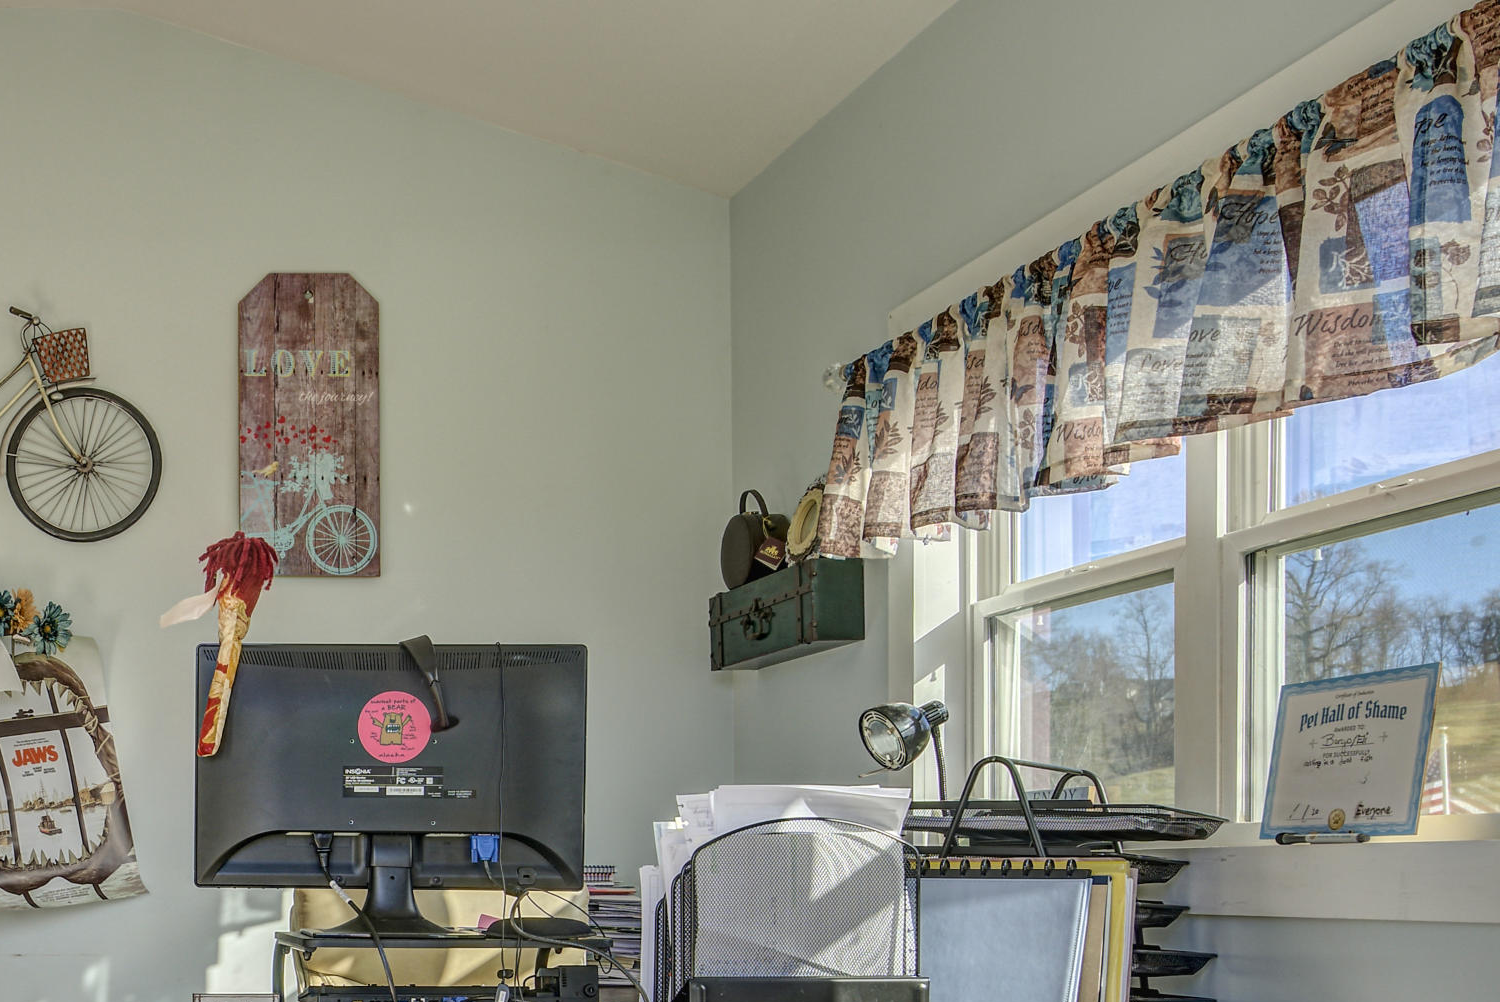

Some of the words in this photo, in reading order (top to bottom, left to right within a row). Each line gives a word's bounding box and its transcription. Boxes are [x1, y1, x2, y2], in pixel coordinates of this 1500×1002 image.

[1412, 113, 1447, 146] pe
[1293, 308, 1373, 337] Wisdo
[1189, 328, 1221, 343] ove
[243, 349, 351, 378] LOVE
[298, 390, 318, 402] the
[318, 391, 375, 406] journey!
[1299, 710, 1319, 734] Pet
[1320, 703, 1346, 726] Hall
[1347, 700, 1364, 720] of
[1365, 699, 1408, 721] Shame
[12, 745, 59, 767] JAWS
[1353, 801, 1394, 820] Everyone
